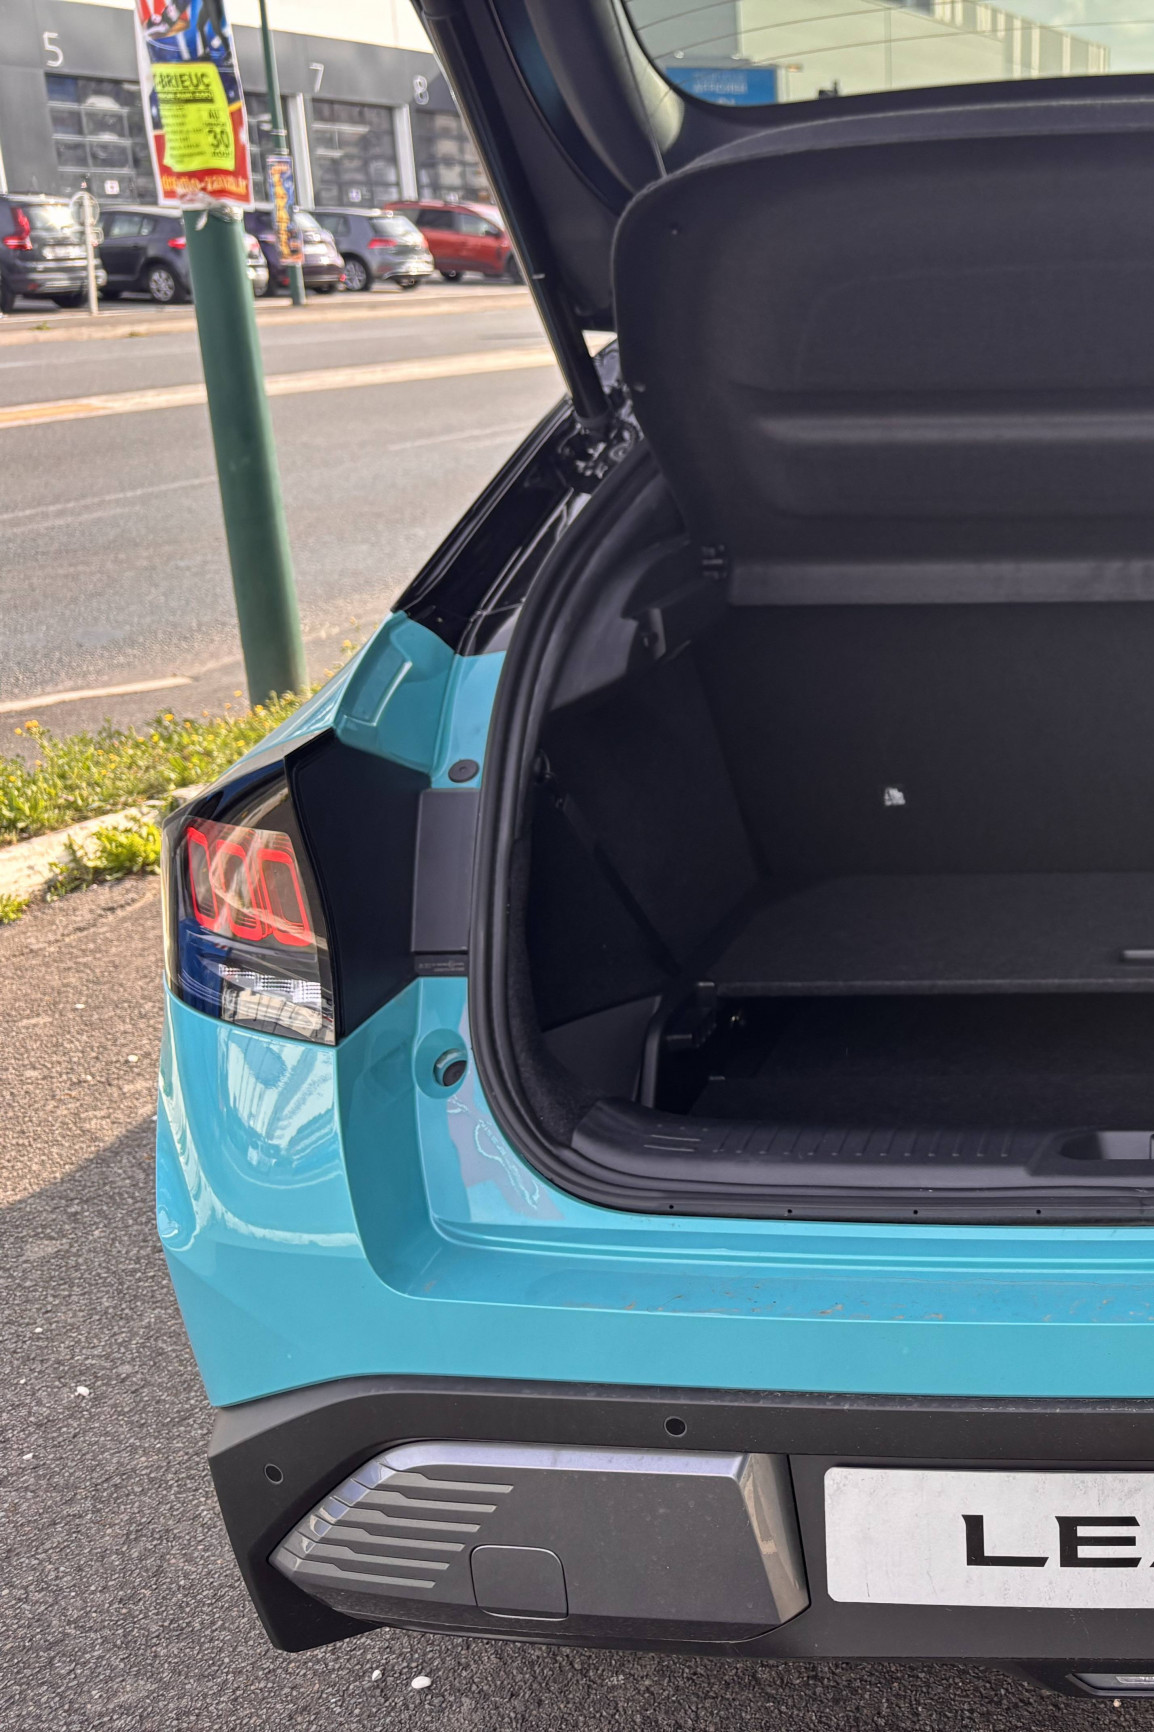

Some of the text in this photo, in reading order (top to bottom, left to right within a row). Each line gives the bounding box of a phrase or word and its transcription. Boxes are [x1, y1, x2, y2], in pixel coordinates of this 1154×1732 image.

[43, 31, 63, 67] 5
[309, 62, 324, 93] 7
[413, 75, 429, 105] 8
[207, 129, 230, 149] 30
